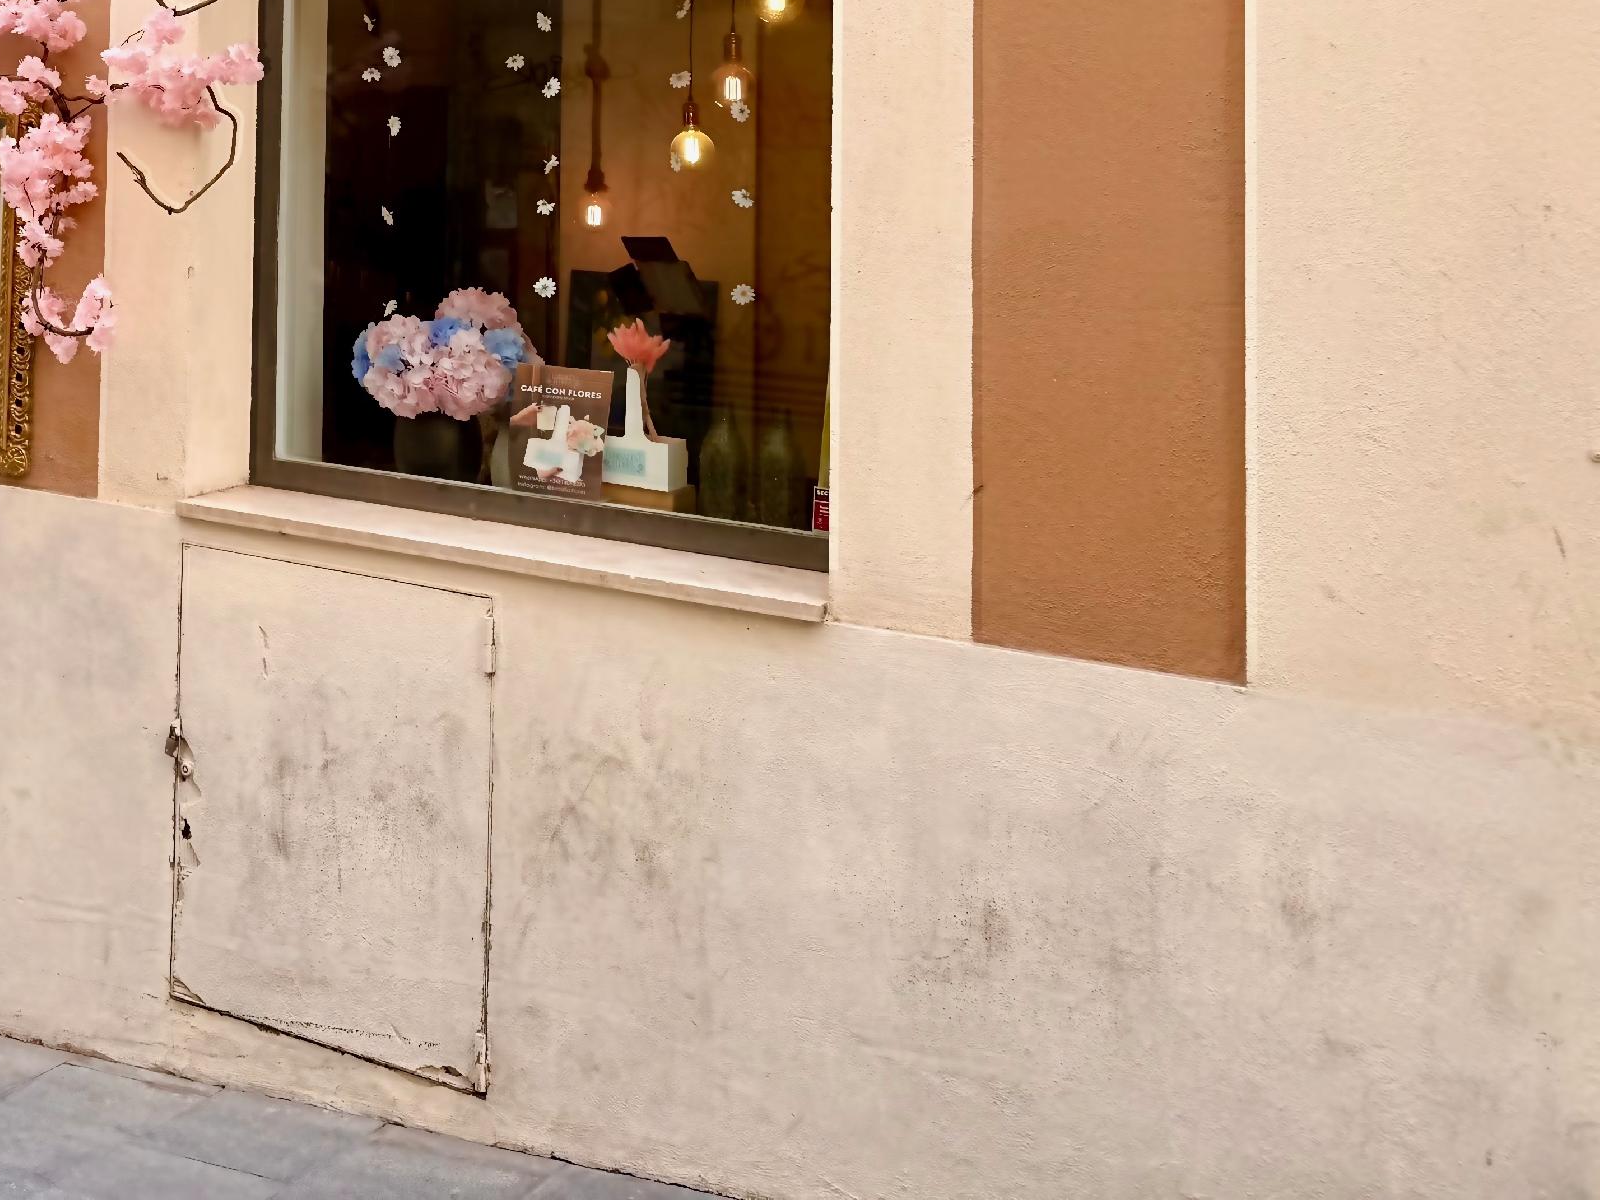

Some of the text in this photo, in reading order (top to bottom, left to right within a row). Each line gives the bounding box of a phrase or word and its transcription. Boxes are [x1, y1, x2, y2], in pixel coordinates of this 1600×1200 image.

[520, 384, 543, 393] CAFÉ
[545, 387, 566, 395] CON
[568, 389, 602, 399] FLORES
